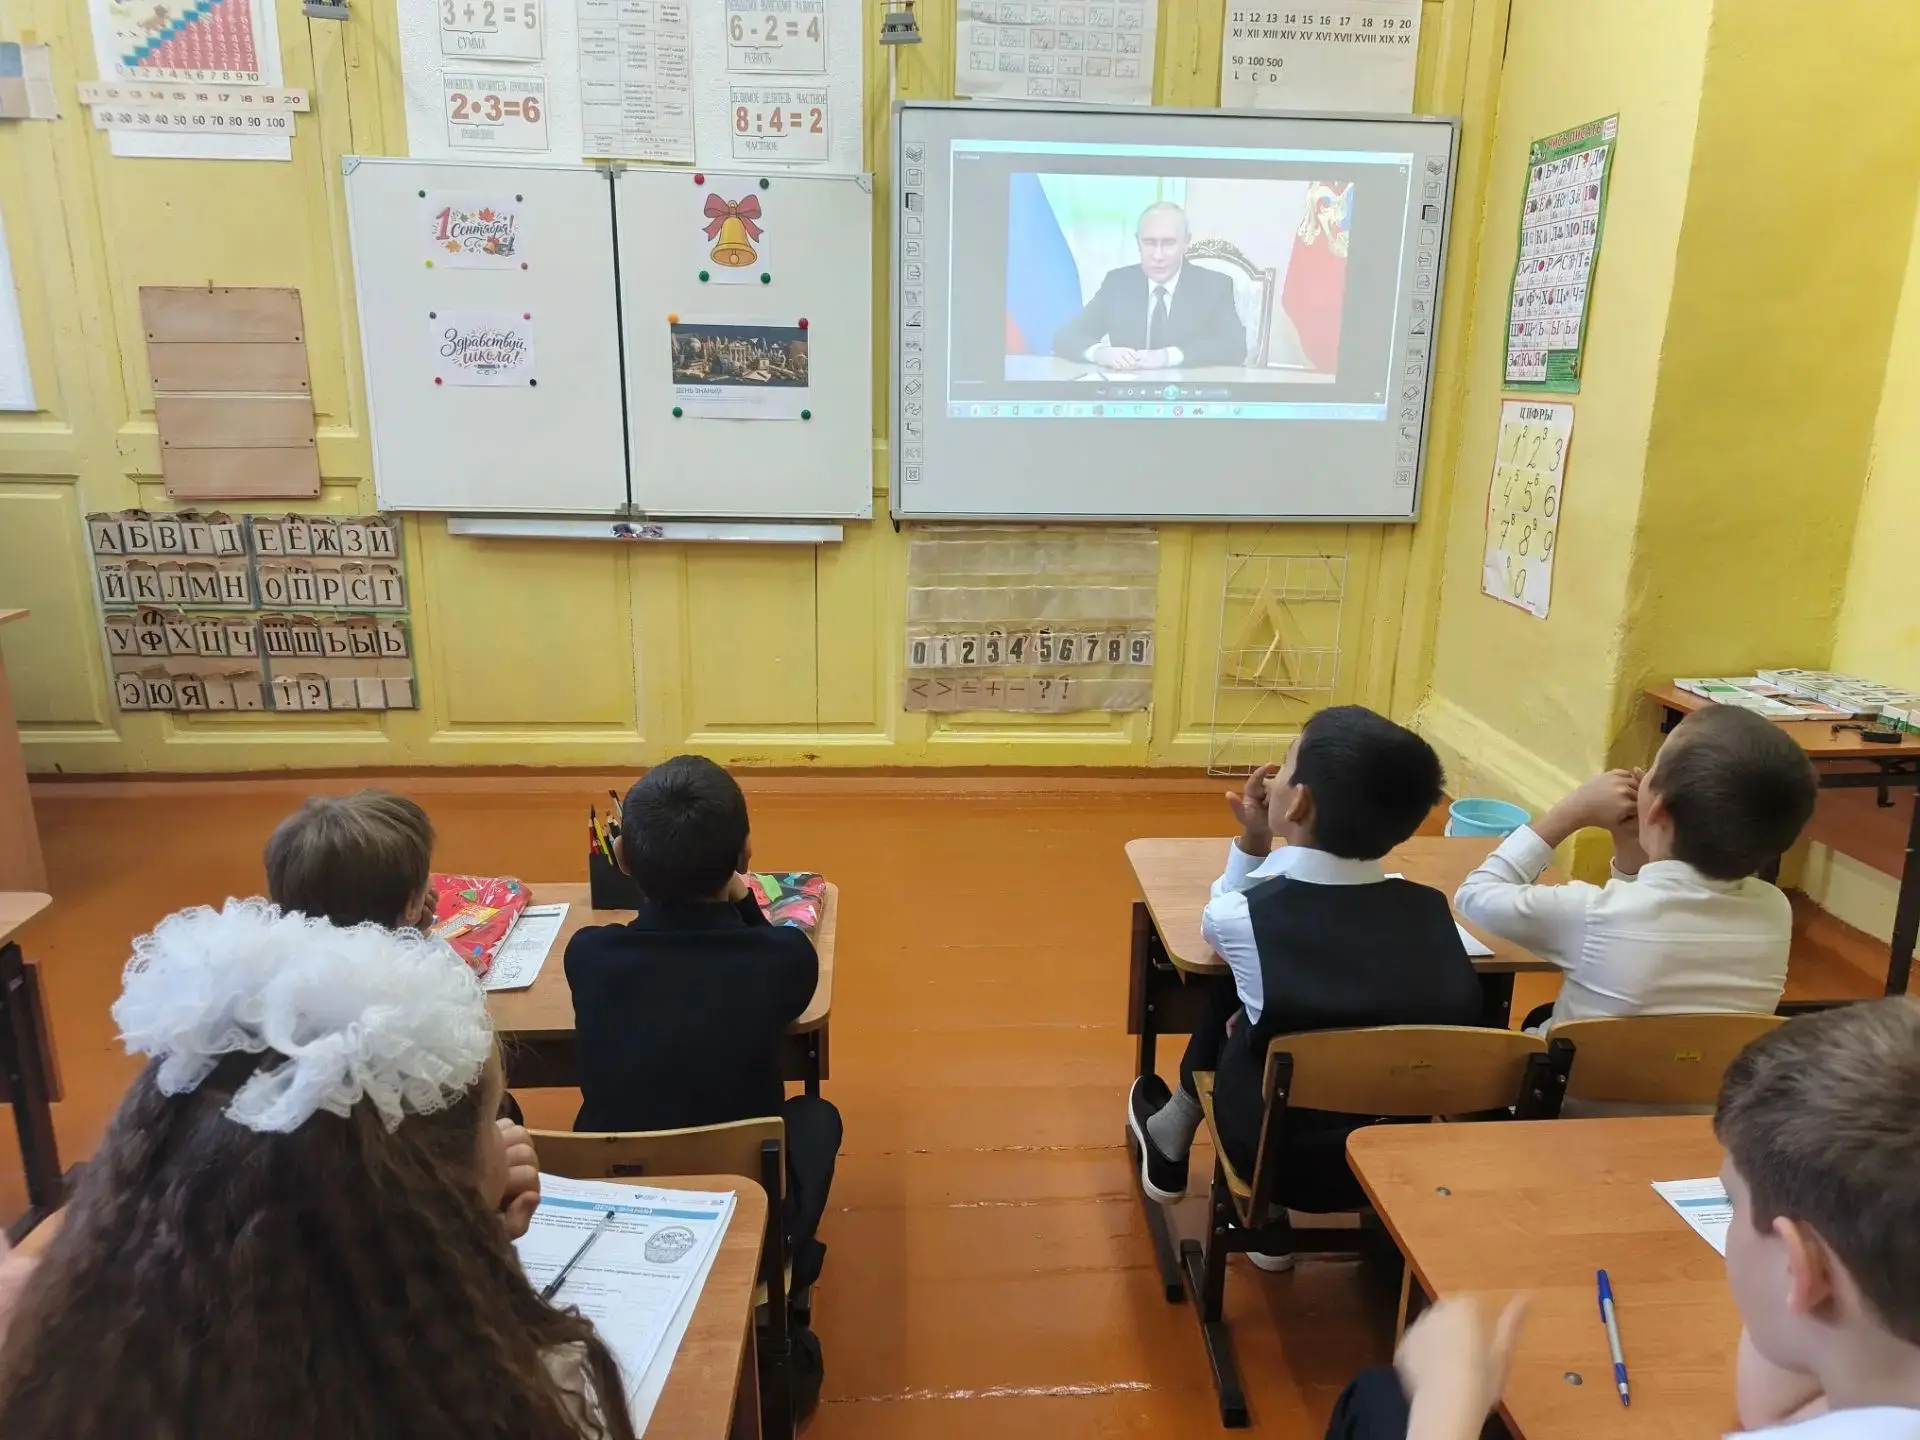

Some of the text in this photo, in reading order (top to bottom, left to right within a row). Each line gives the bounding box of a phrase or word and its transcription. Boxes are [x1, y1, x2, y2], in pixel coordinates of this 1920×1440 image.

[483, 1, 496, 26] 2
[523, 3, 536, 29] 5
[1232, 13, 1411, 28] 11 12 13 14 15 16 17 18 19 20
[730, 15, 743, 41] 6
[765, 15, 778, 41] 2
[806, 16, 820, 42] 4
[1232, 28, 1410, 43] XI XII XIII XIV XV XVI XVII XVIII XIX XX
[1232, 56, 1283, 67] 50 100 500
[246, 73, 258, 81] 10
[1252, 72, 1258, 81] C
[1270, 74, 1277, 82] D
[154, 113, 168, 124] 40
[173, 114, 186, 125] 50
[192, 116, 205, 125] 60
[210, 116, 224, 126] 70
[229, 117, 242, 126] 80
[248, 117, 261, 126] 90
[266, 118, 285, 127] 100
[736, 106, 749, 131] 8
[769, 107, 783, 132] 4
[810, 108, 822, 133] 2
[435, 207, 515, 240] 1 Сентября!
[440, 328, 527, 357] Здравствуй,
[463, 350, 520, 365] школа!
[1520, 408, 1553, 420] ЦИФРЫ
[1527, 436, 1541, 468] 2
[1549, 438, 1563, 471] 3
[1522, 481, 1533, 512] 5
[1544, 485, 1556, 517] 6
[99, 526, 390, 553] А Б В Г Д Е Ё Ж З И
[1519, 525, 1531, 556] 8
[1540, 531, 1553, 562] 9
[106, 574, 393, 600] Й К Л М Н О П Р С Т
[1514, 569, 1526, 598] 0
[112, 628, 402, 653] У Ф Х Ц Ч Ш Щ Ъ Ы Ь
[913, 637, 1144, 664] 0 1 2 3 4 5 6 7 8 9
[123, 683, 140, 704] Э
[150, 683, 172, 704] Ю
[182, 686, 201, 705] Я
